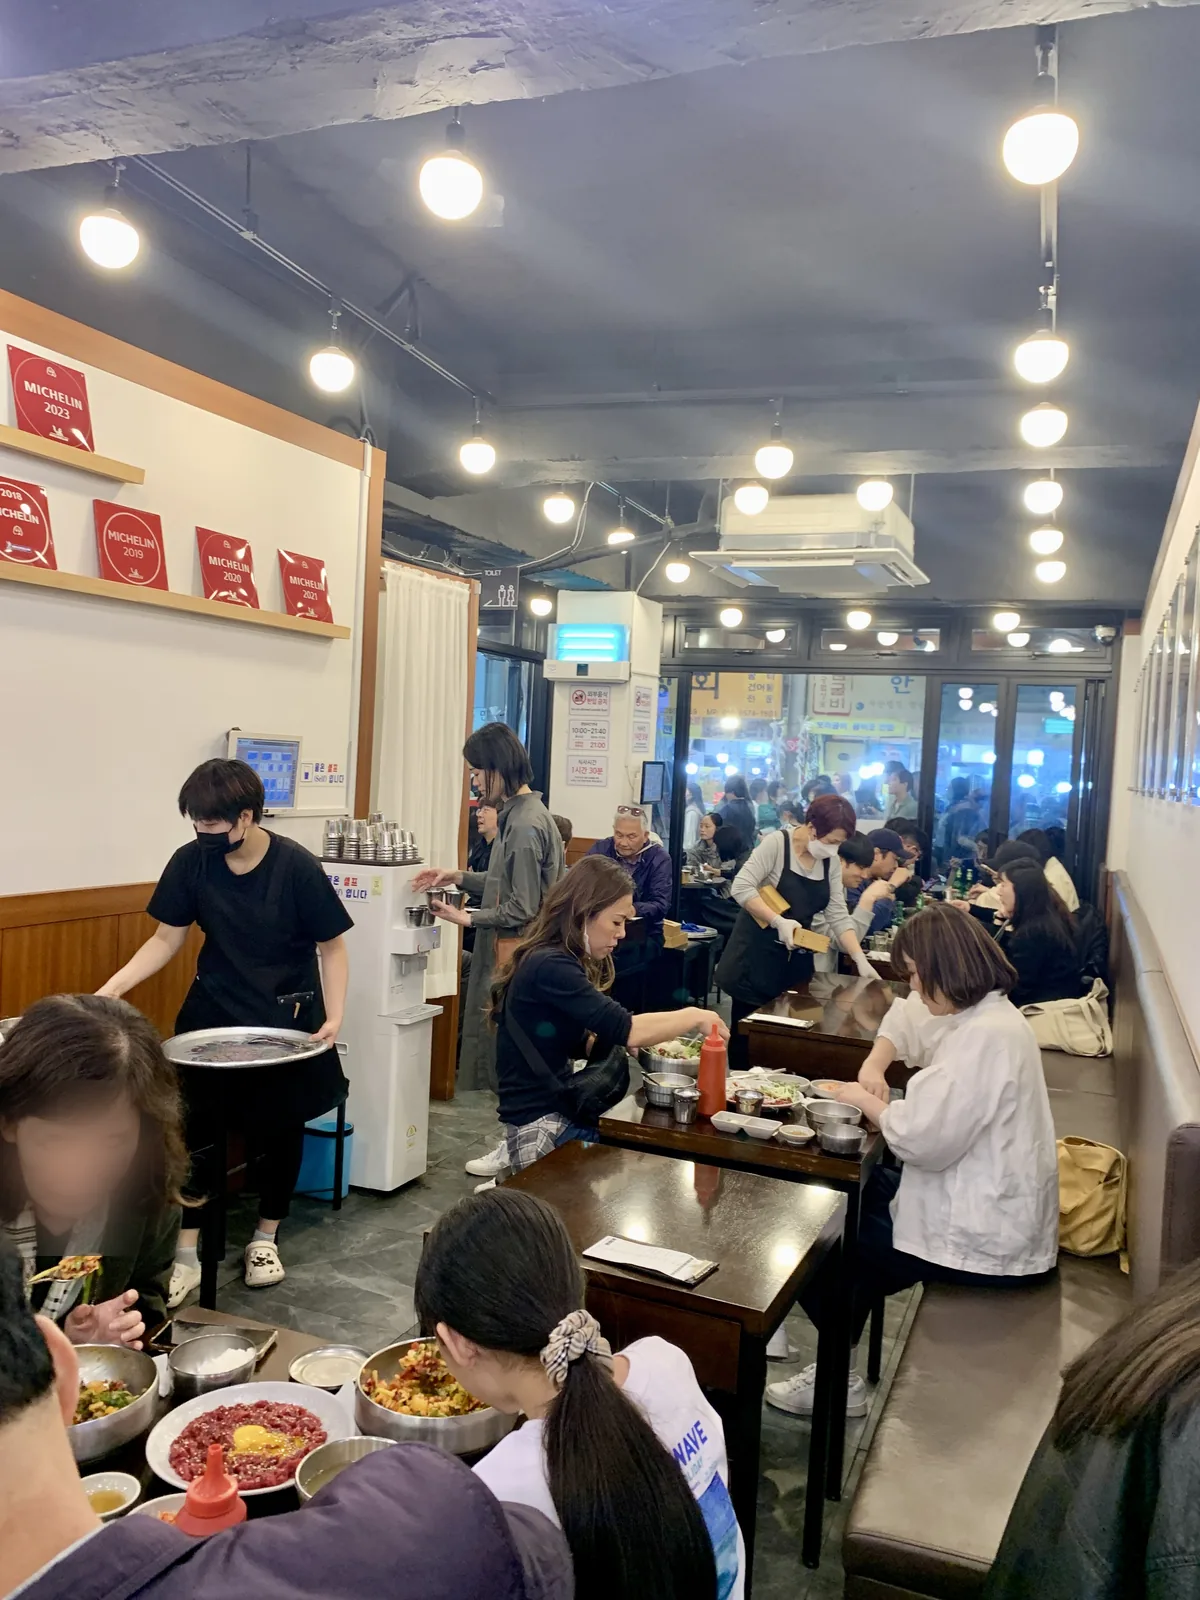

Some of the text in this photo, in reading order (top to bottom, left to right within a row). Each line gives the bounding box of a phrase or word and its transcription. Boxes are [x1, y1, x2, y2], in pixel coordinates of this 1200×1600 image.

[24, 380, 83, 411] MICHELIN
[44, 401, 71, 420] 2023
[0, 487, 23, 501] 2018
[0, 507, 40, 525] ICHELIN
[107, 529, 155, 550] MICHELIN
[123, 546, 144, 559] 2019
[208, 555, 251, 574] MICHELIN
[223, 571, 242, 584] 2020
[289, 575, 325, 592] MICHELIN
[302, 589, 318, 601] 2021
[343, 876, 358, 887] 셀프
[345, 888, 368, 899] 입니다
